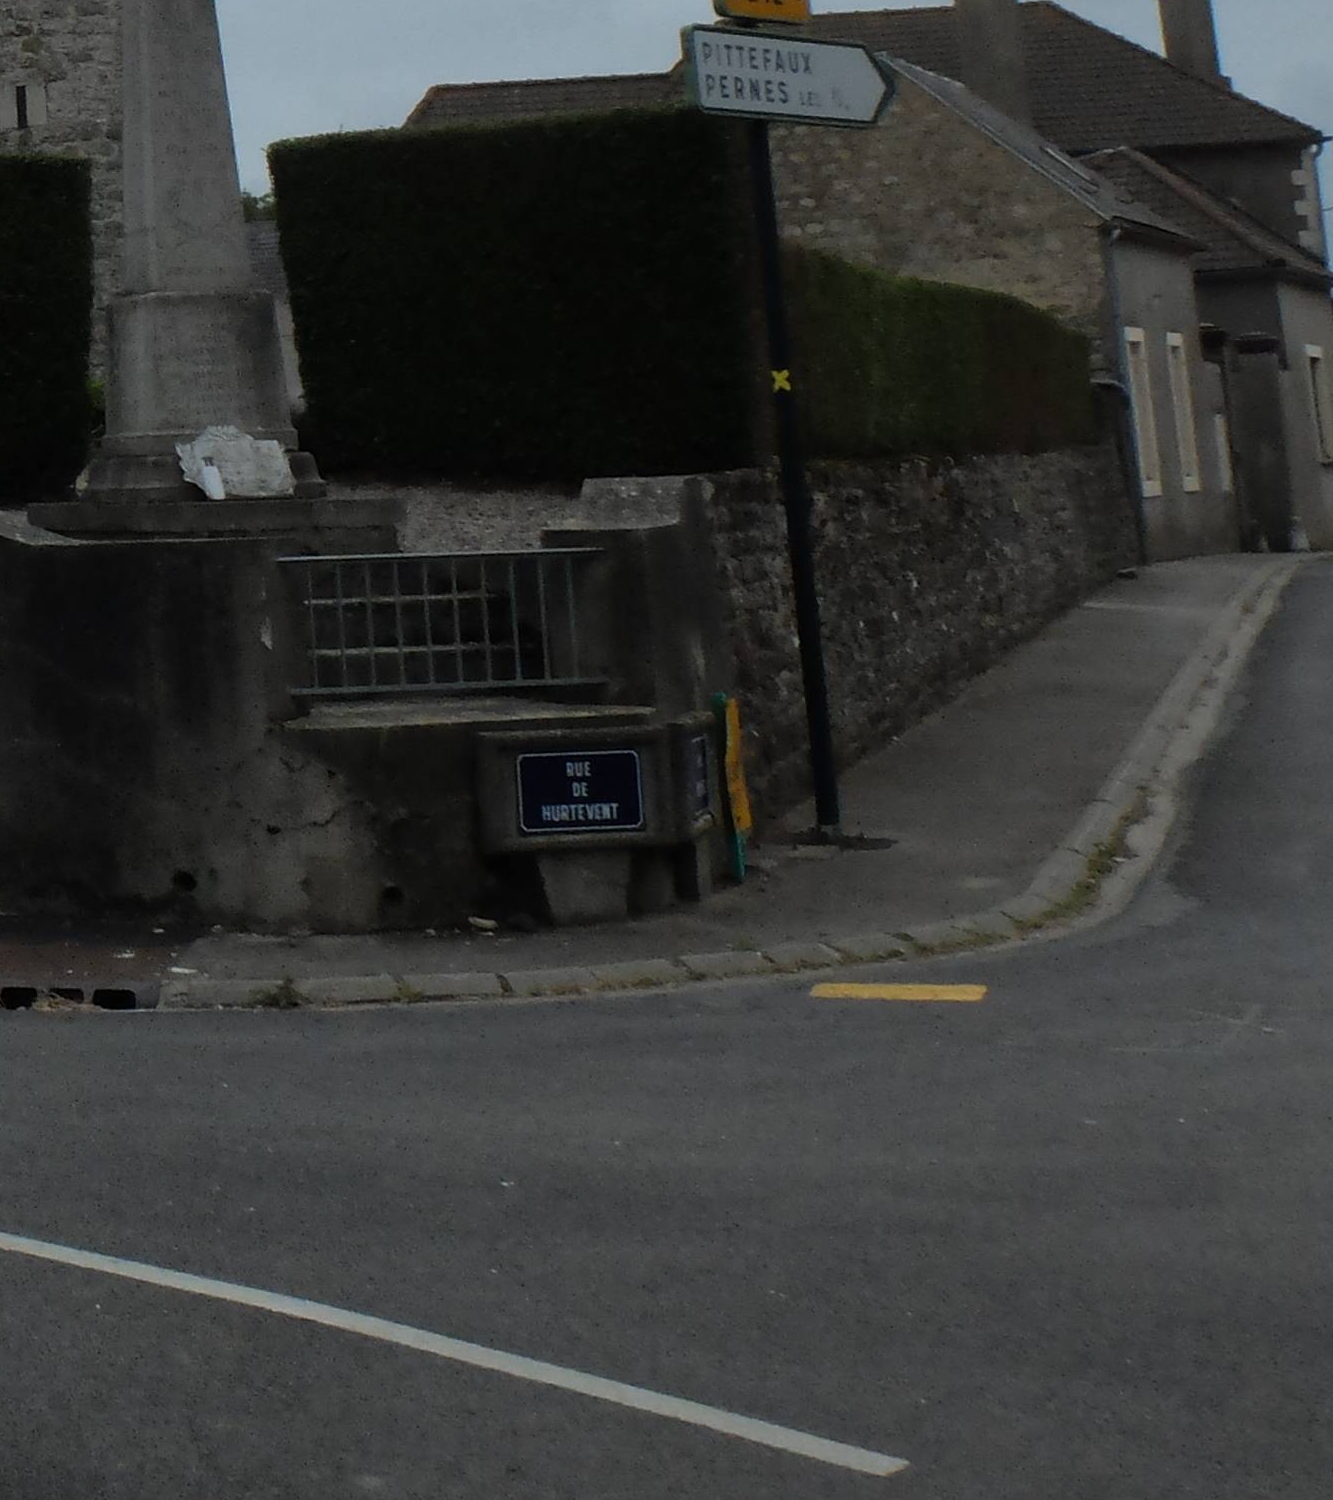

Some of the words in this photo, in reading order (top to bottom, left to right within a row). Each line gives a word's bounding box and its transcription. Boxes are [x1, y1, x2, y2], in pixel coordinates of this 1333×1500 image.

[701, 42, 813, 75] PITTEFAUX
[705, 74, 790, 104] PERNES
[566, 761, 592, 778] RUE
[572, 782, 589, 797] DE
[541, 802, 620, 822] HURTEVENT
